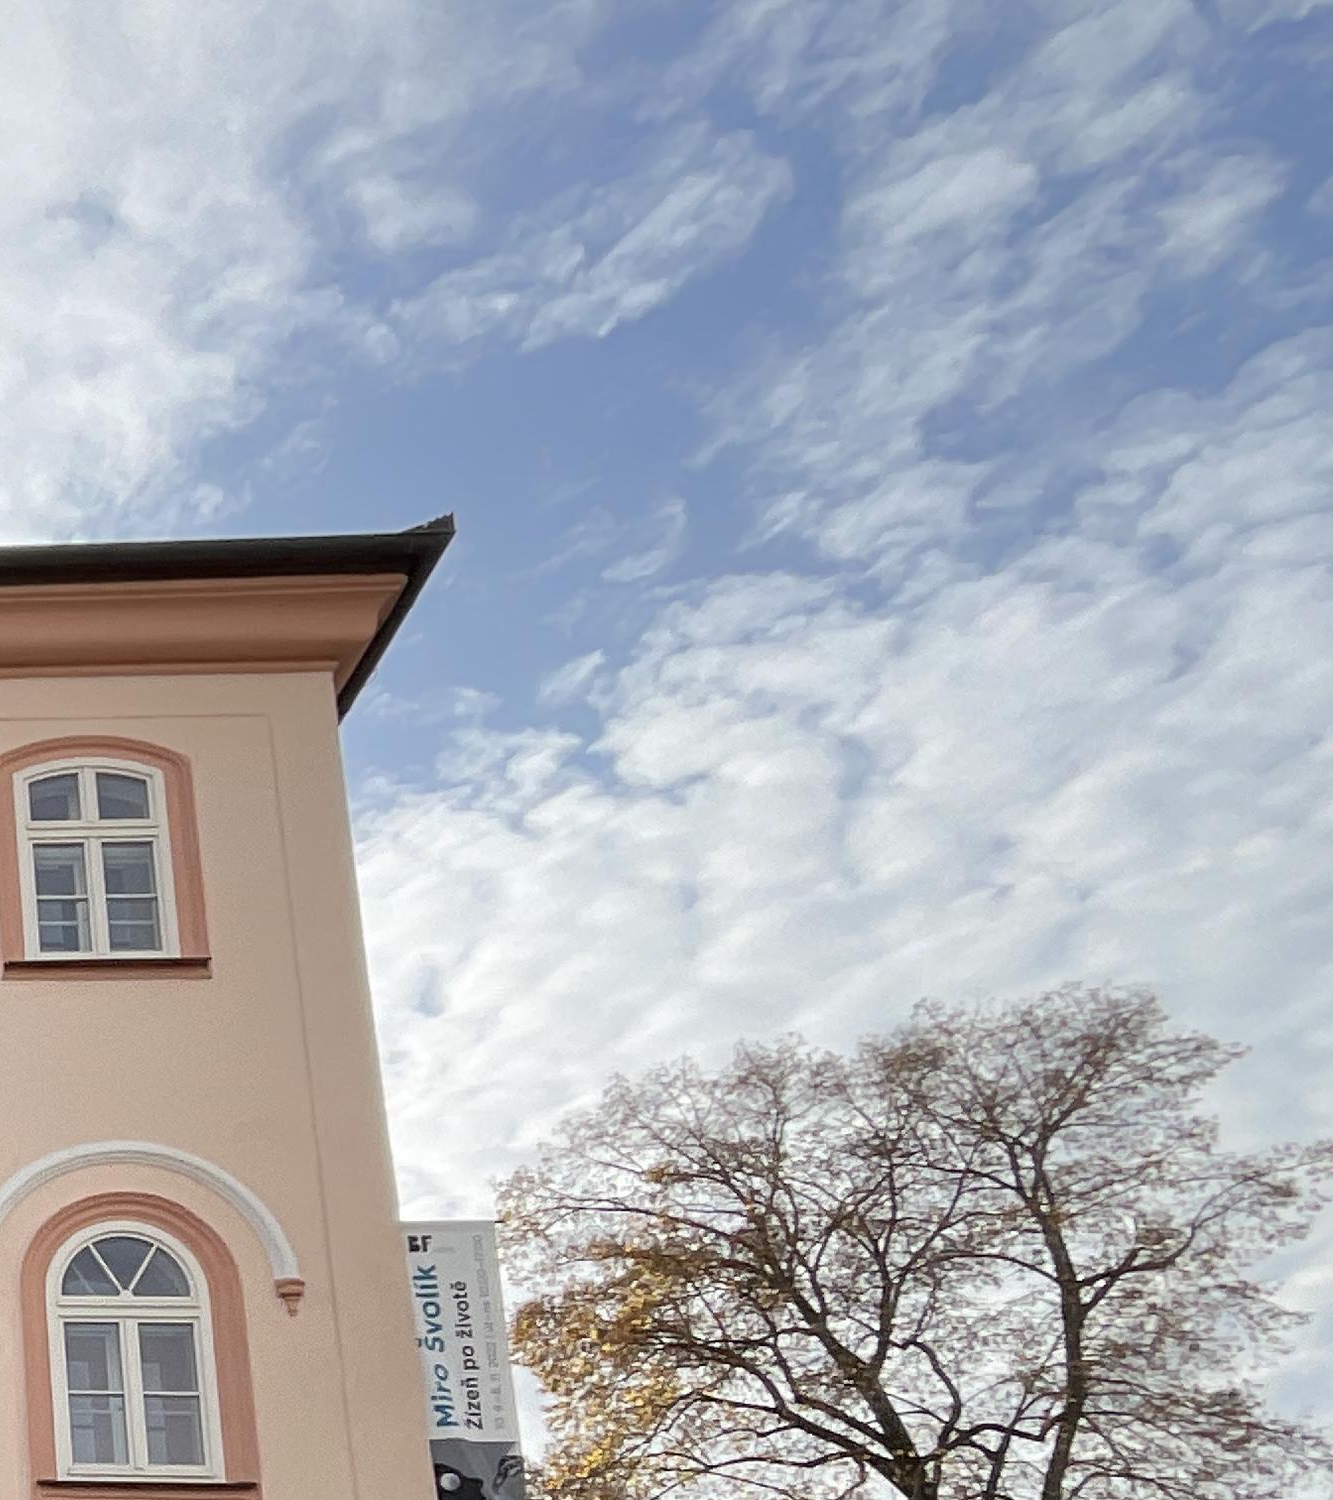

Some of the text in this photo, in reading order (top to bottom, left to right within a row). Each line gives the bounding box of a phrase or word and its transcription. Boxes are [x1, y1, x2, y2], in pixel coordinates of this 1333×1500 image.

[413, 1264, 460, 1427] Miro Švolík
[462, 1345, 480, 1370] po
[461, 1377, 484, 1430] Žízeň
